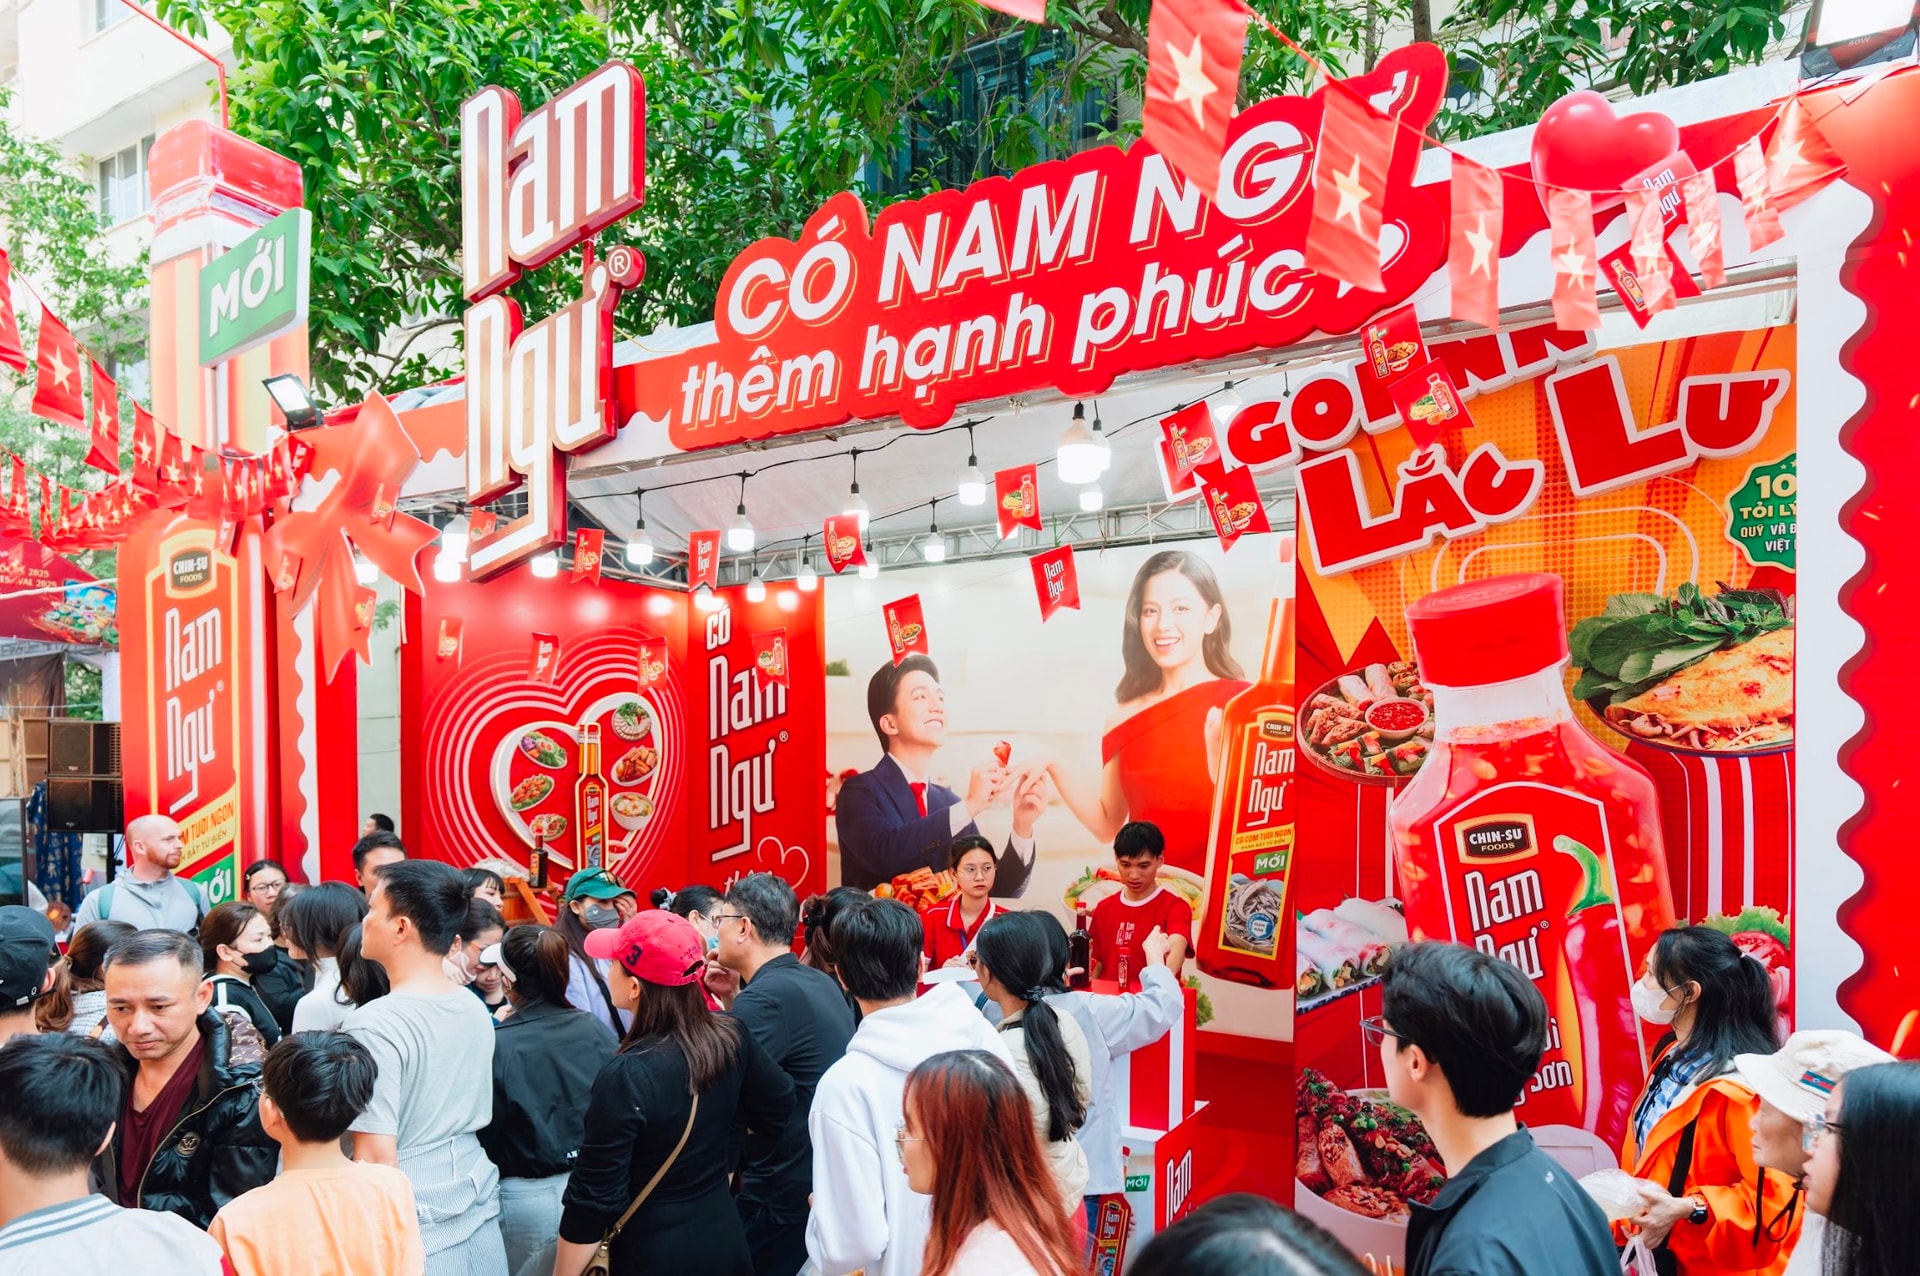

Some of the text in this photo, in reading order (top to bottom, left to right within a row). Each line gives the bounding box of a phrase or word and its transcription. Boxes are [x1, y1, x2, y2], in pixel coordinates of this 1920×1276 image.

[464, 65, 630, 293] Nam
[728, 215, 851, 336] CÓ
[878, 170, 1099, 303] NAM
[209, 234, 285, 338] MỚI
[681, 233, 1306, 425] thêm hạnh phúc
[1299, 362, 1780, 568] LẮC LƯ
[1739, 501, 1773, 519] TỎI
[1764, 538, 1791, 553] VIỆT
[173, 556, 208, 575] CHIN-SU
[180, 572, 203, 583] FOODS
[706, 603, 731, 650] CÓ
[165, 607, 222, 693] Nam
[1253, 742, 1295, 777] Nam
[1469, 829, 1523, 845] CHIN-SU
[1481, 842, 1516, 852] FOODS
[1256, 854, 1285, 870] MỚI
[1465, 869, 1544, 932] Nam
[626, 945, 643, 967] 3
[1126, 1175, 1147, 1188] MỚI
[1167, 1149, 1192, 1228] Nam
